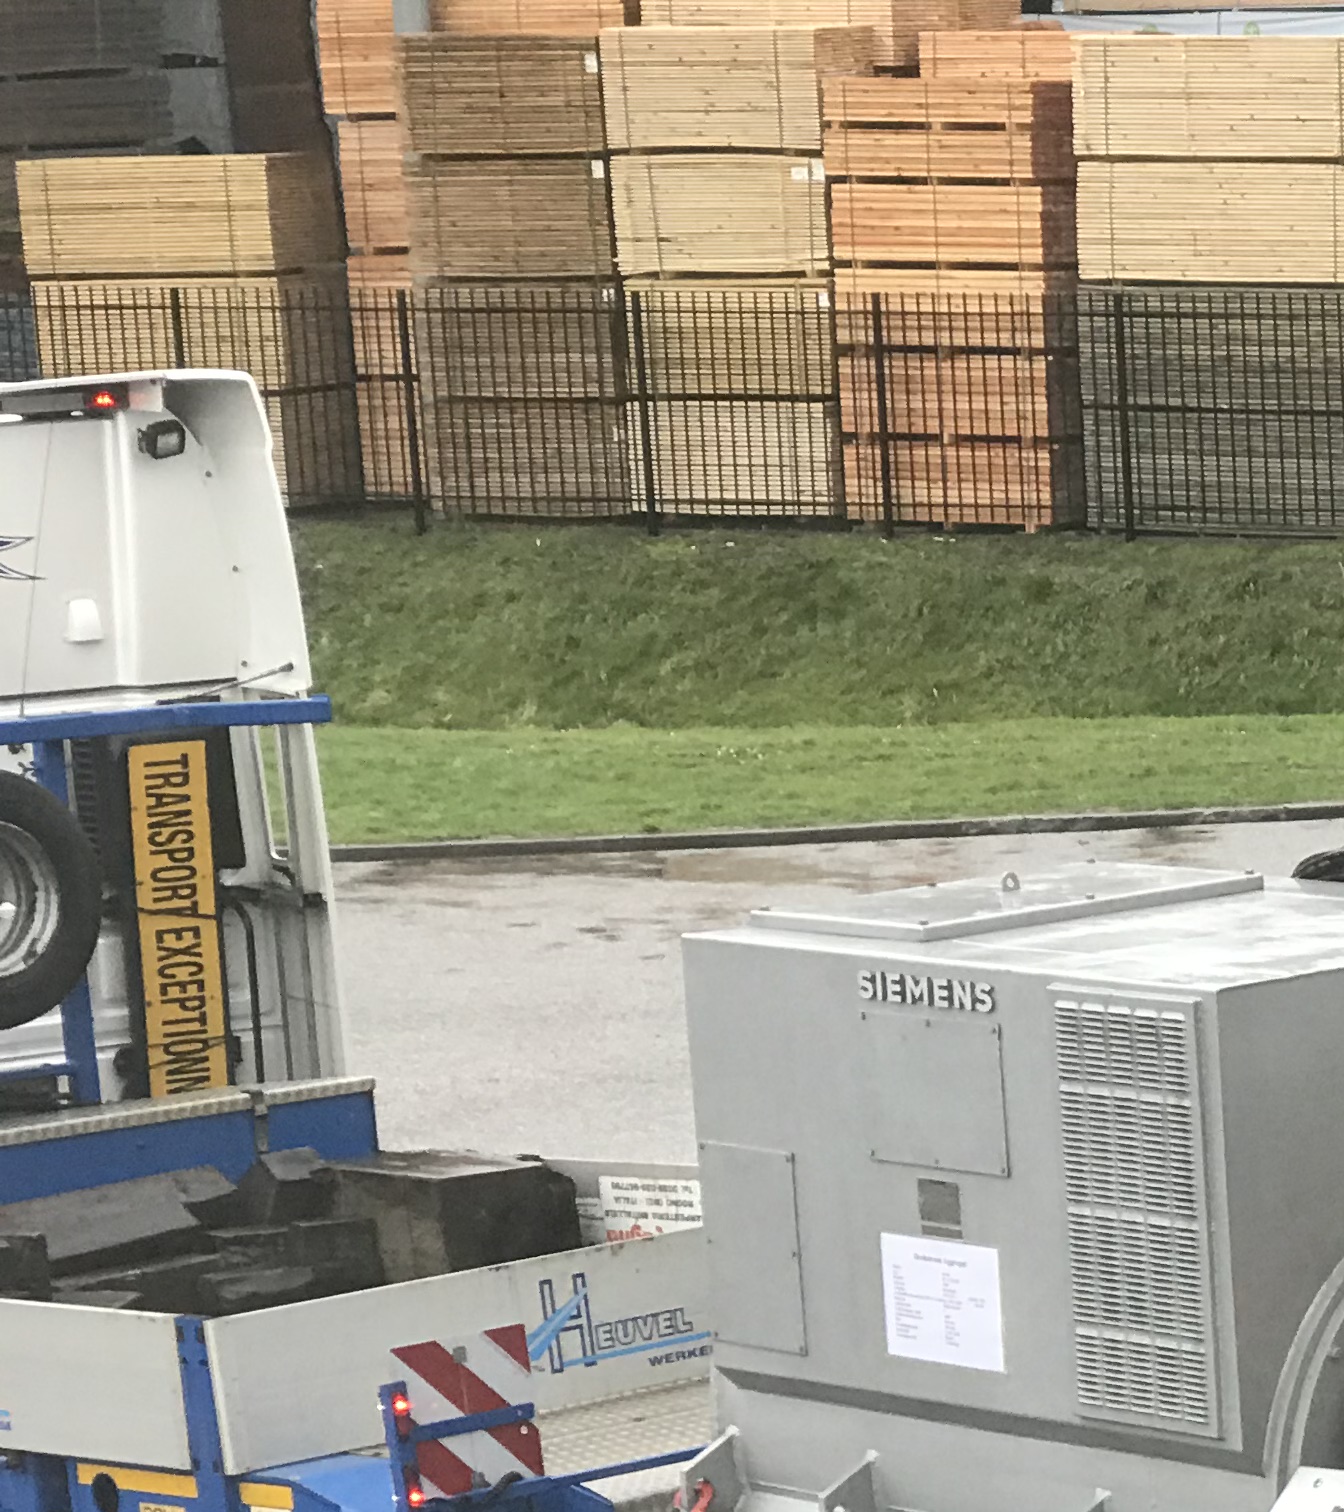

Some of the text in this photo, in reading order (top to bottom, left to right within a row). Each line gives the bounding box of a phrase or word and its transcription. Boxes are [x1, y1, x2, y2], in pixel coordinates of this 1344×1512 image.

[143, 752, 201, 918] TRANSPORT
[857, 969, 995, 1013] SIEMENS
[538, 1272, 694, 1374] HEUVEL
